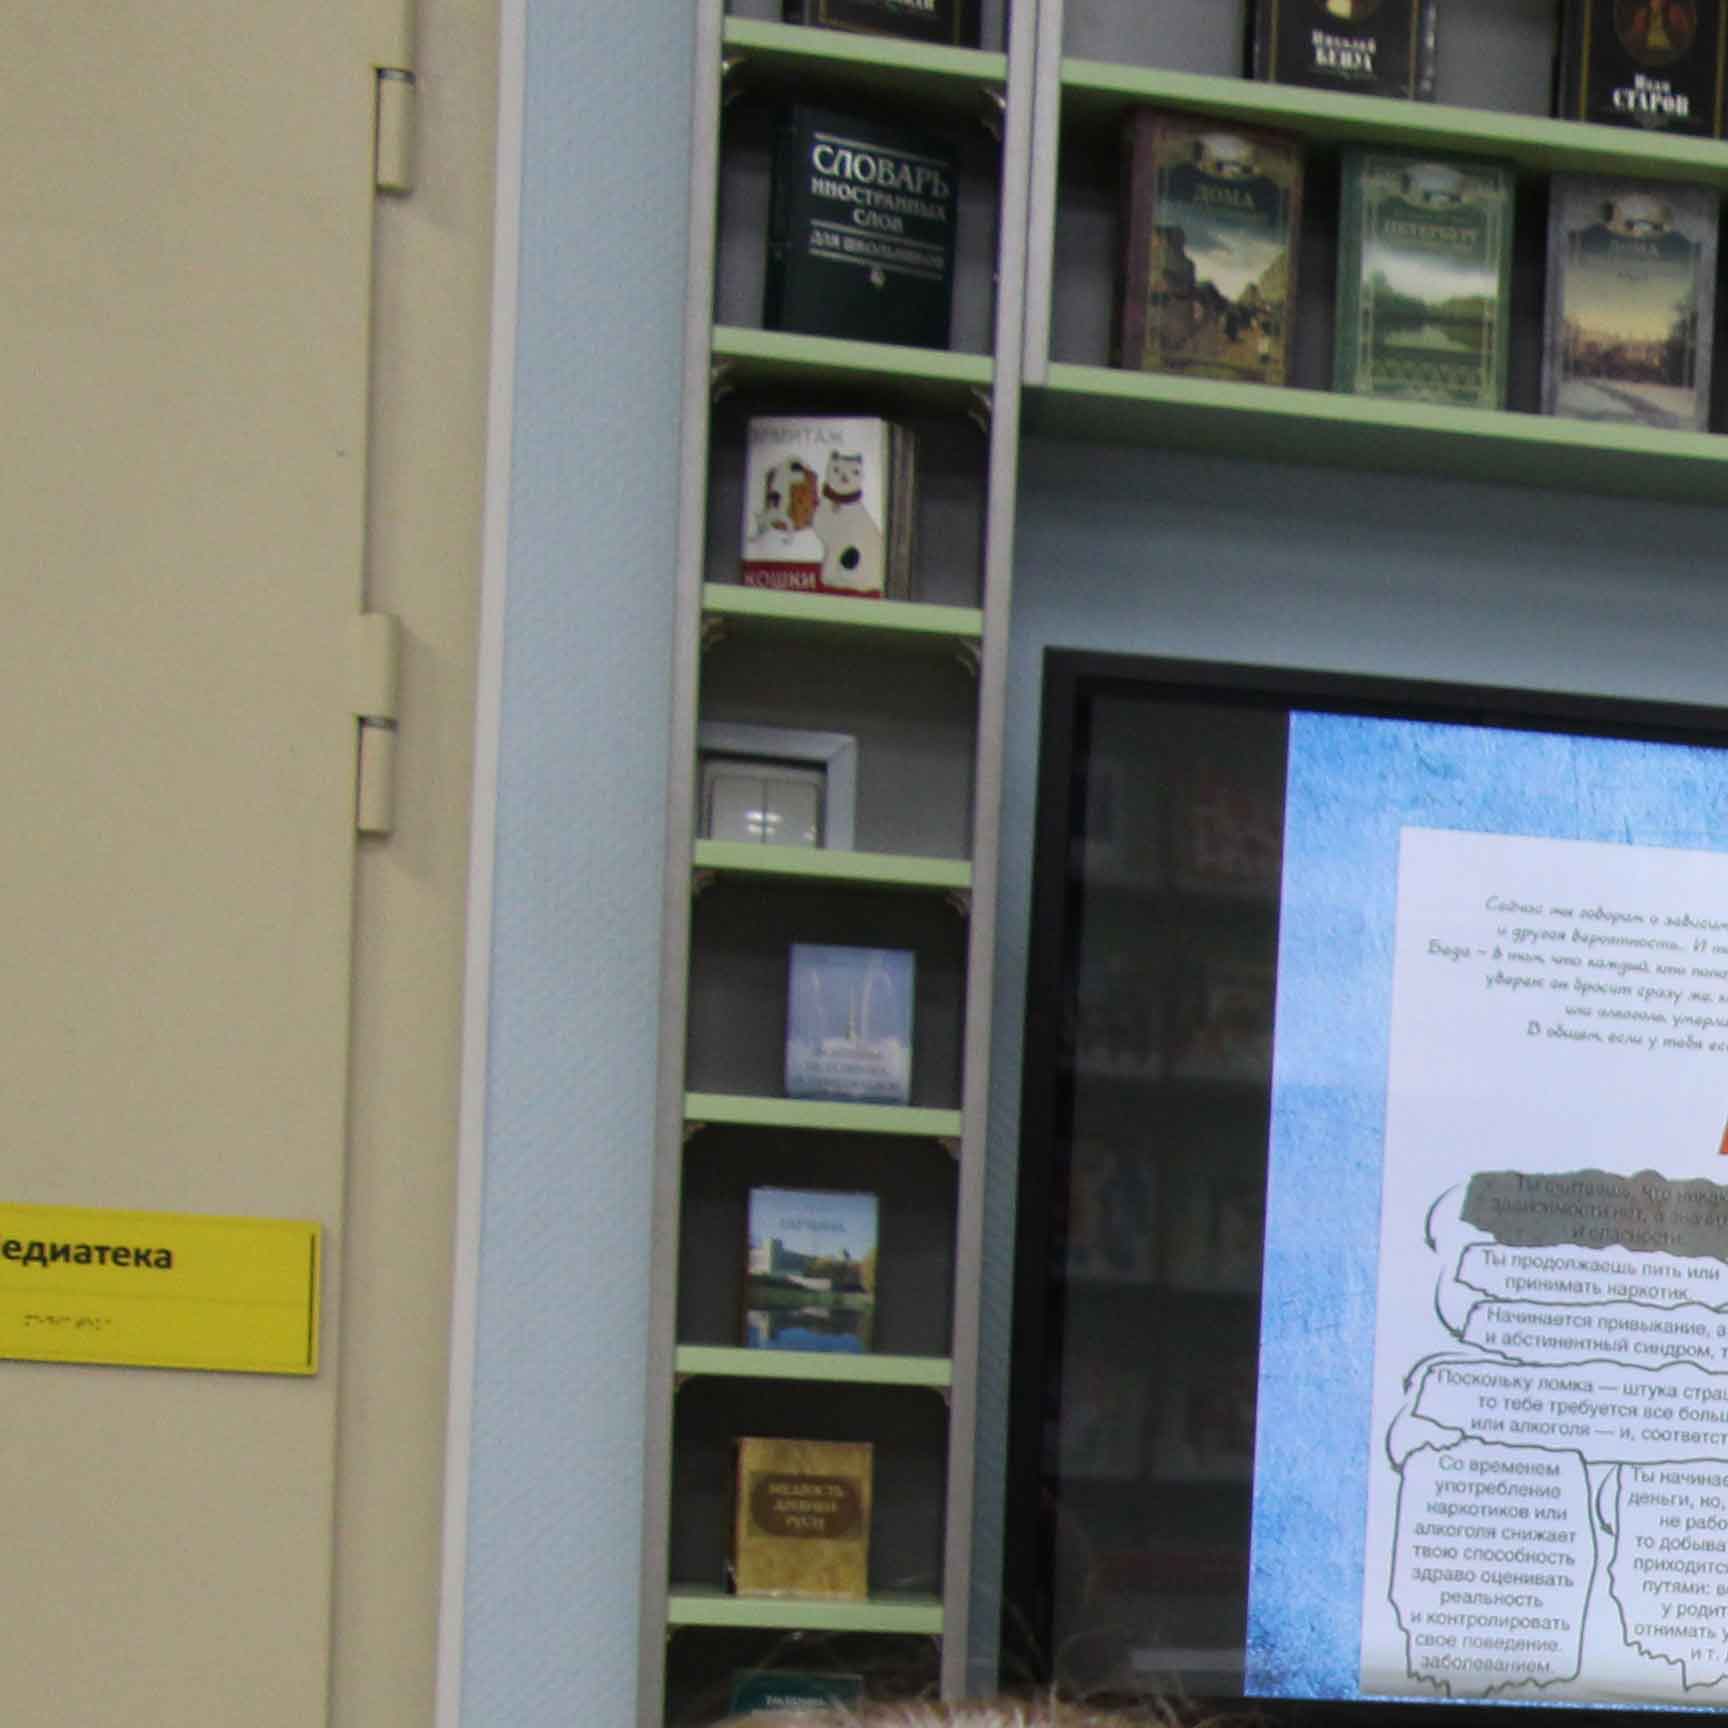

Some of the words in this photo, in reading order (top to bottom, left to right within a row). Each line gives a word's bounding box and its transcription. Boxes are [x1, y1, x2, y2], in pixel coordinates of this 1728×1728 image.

[811, 143, 951, 199] СЛОВАРЬ
[1486, 1309, 1593, 1328] Начинается
[1501, 1333, 1629, 1353] абстинентный
[1437, 1371, 1533, 1390] Поскольку
[1537, 1377, 1595, 1393] ломка
[1622, 1382, 1678, 1399] штука
[1477, 1395, 1498, 1409] то
[1503, 1397, 1544, 1412] тебе
[1549, 1399, 1639, 1418] требуется
[1642, 1406, 1674, 1420] все
[1470, 1417, 1505, 1431] или
[1508, 1419, 1592, 1437] алкоголя
[1631, 1466, 1656, 1484] Ты
[1658, 1515, 1681, 1527] не
[1635, 1535, 1656, 1549] то
[1660, 1602, 1673, 1618] у
[1633, 1623, 1718, 1639] отнимать
